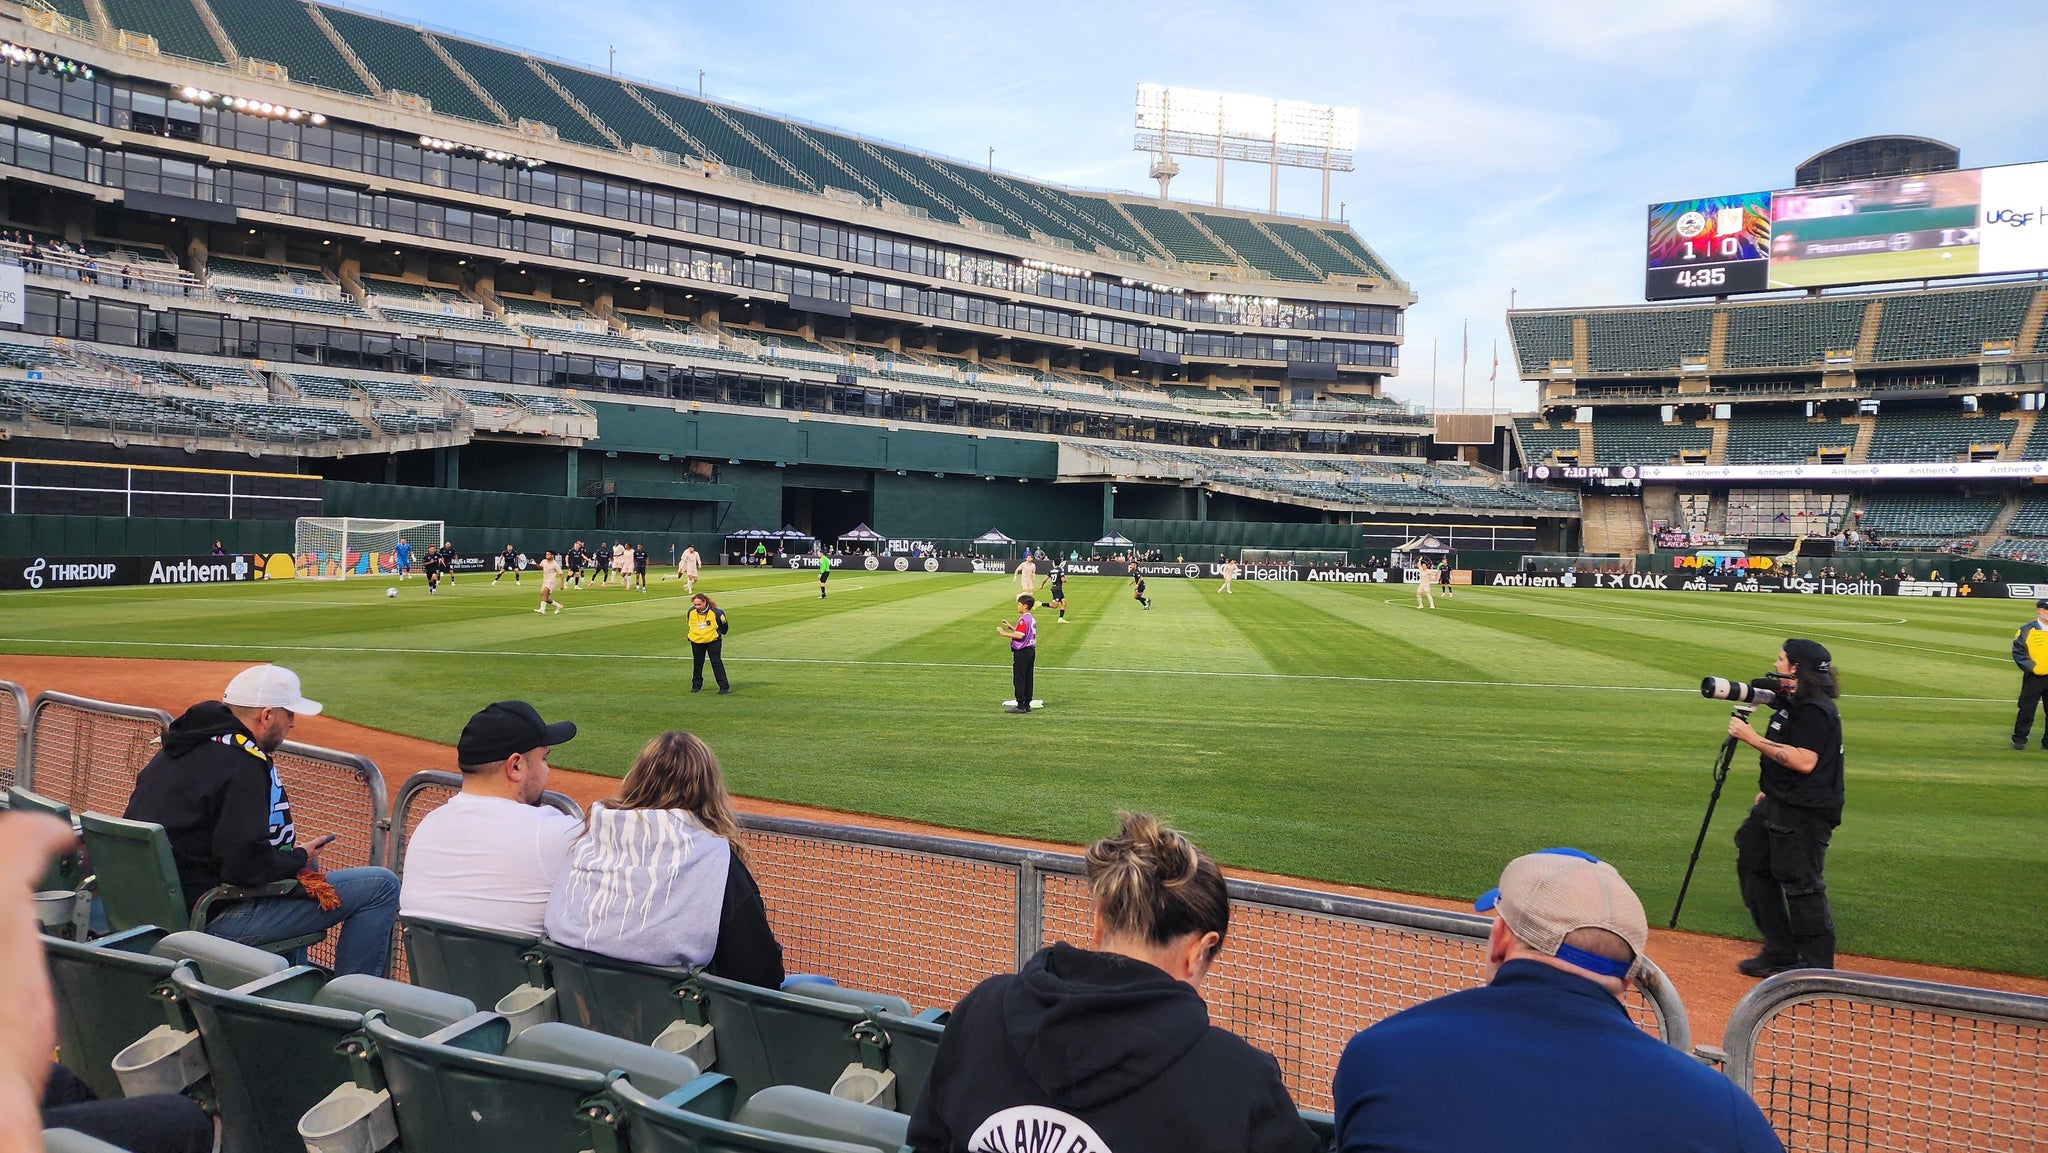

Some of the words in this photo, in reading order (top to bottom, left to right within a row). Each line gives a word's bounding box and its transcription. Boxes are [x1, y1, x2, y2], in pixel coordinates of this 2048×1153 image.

[1987, 209, 2034, 227] UCSF
[1683, 241, 1696, 259] 1
[1722, 237, 1738, 255] 0
[1676, 268, 1726, 287] 4:35
[1563, 467, 1587, 477] 7:10
[1588, 467, 1609, 477] PM
[1990, 466, 2031, 474] Anthem
[888, 540, 909, 552] FIELD
[803, 558, 842, 567] THRUP
[1068, 565, 1099, 573] FALCK
[1674, 556, 1773, 570] FAIRYLAND
[49, 564, 116, 580] THREDUP
[149, 559, 228, 583] Anthem
[1128, 565, 1181, 575] Pnumbra
[1211, 564, 1242, 580] UCF
[1245, 564, 1298, 581] Health
[1307, 568, 1370, 582] Anthem
[1493, 573, 1558, 587] Anthem
[1594, 573, 1603, 587] I
[1629, 575, 1668, 588] OAK
[1682, 581, 1706, 590] Ava
[1734, 582, 1758, 592] Ava
[1784, 577, 1818, 594] UCSF
[1822, 579, 1882, 595] Health
